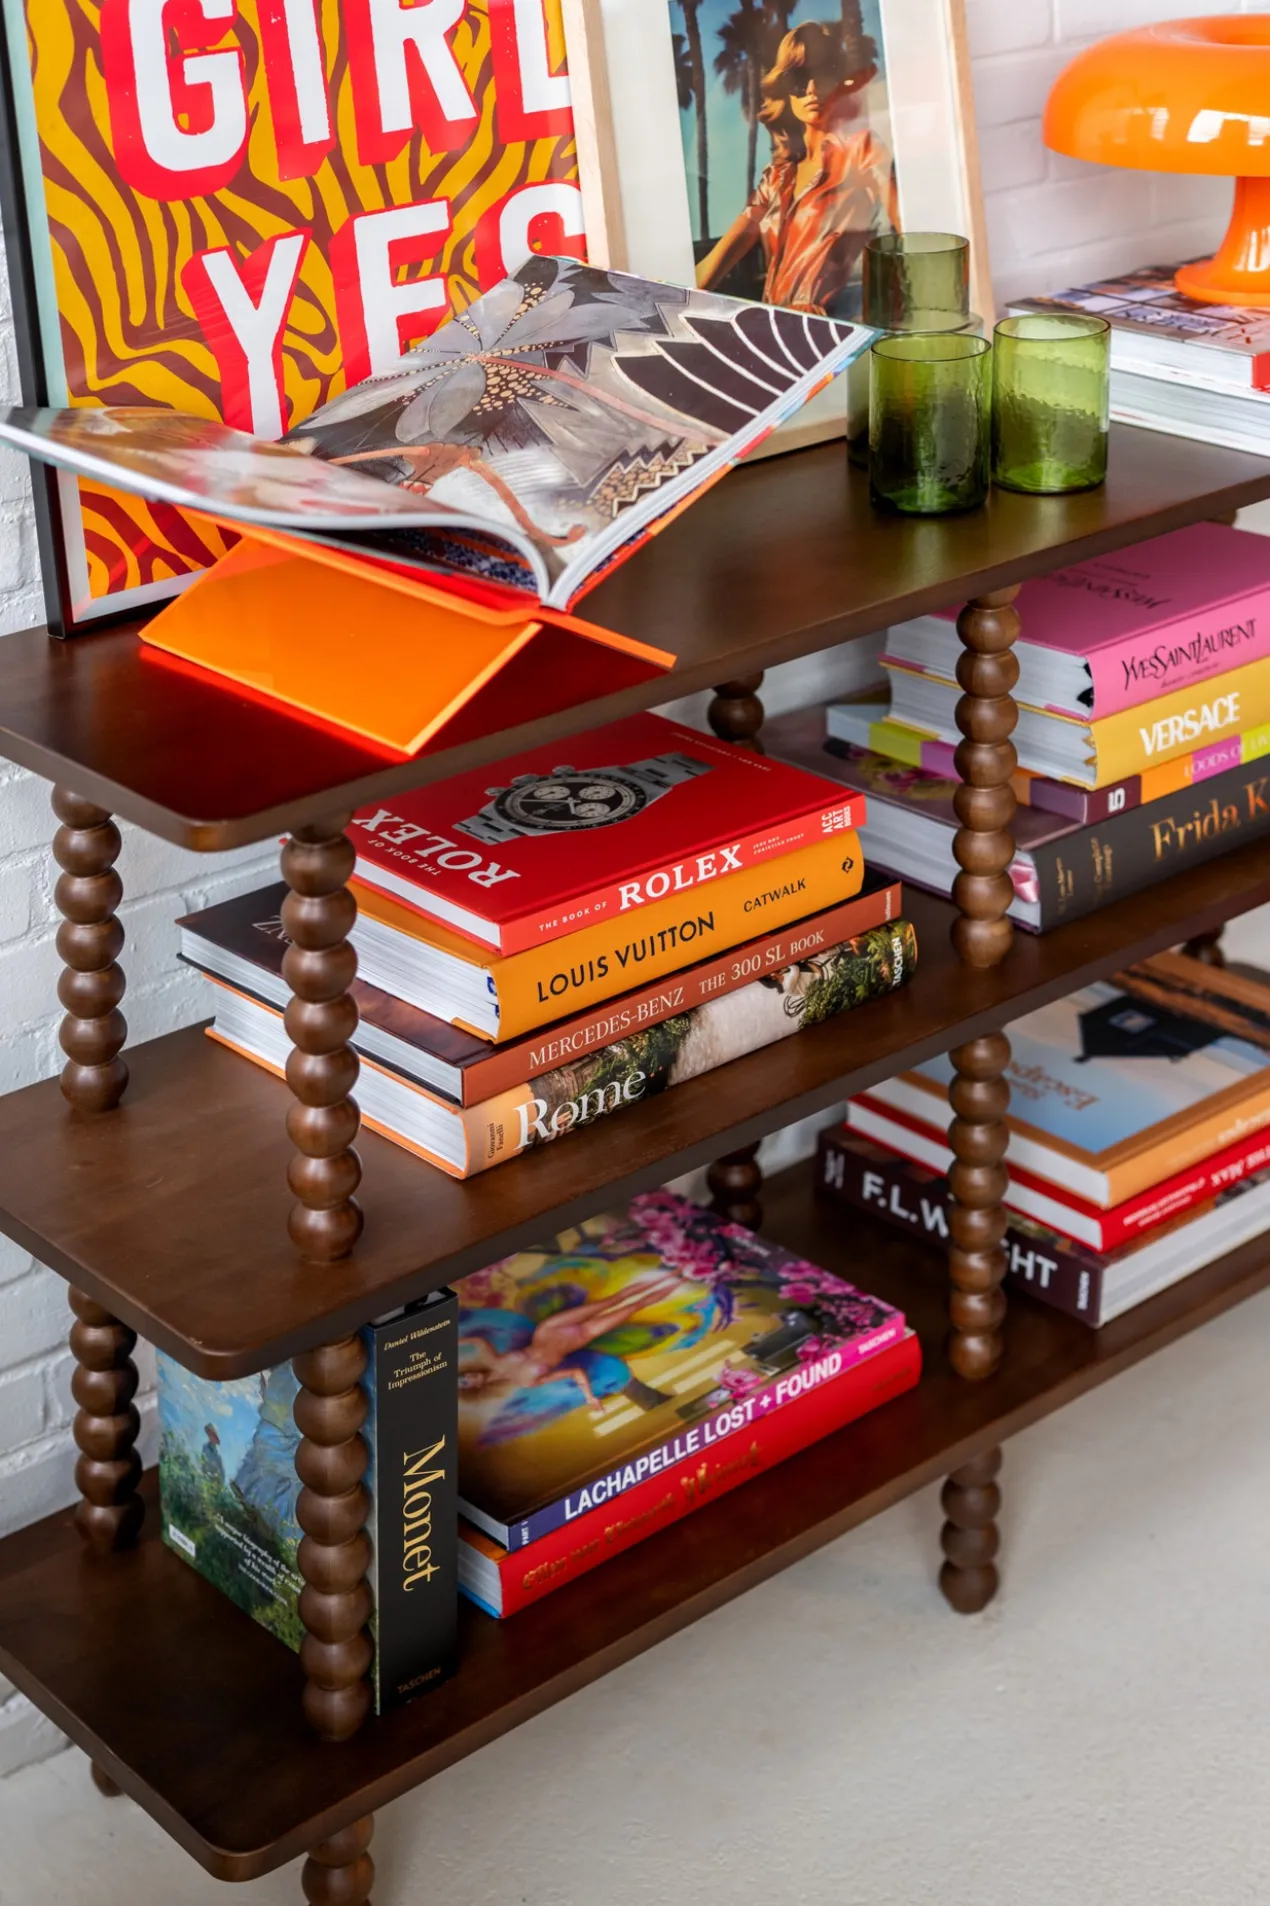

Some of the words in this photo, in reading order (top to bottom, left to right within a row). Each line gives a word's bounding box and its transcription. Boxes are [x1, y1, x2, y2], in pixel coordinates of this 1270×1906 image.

[112, 0, 573, 190] GIRL
[1139, 691, 1240, 757] VERSACE
[822, 812, 834, 833] ACC
[832, 808, 844, 829] ART
[1149, 798, 1241, 862] Frida
[351, 808, 522, 889] ROLEX
[367, 838, 385, 849] OF
[384, 846, 419, 865] BOOK
[417, 862, 443, 877] THE
[538, 918, 558, 932] THE
[561, 906, 591, 924] BOOK
[594, 900, 608, 912] OF
[618, 843, 744, 911] ROLEX
[536, 955, 609, 1004] LOUIS
[614, 911, 716, 970] VUITTON
[743, 877, 807, 913] CATWALK
[526, 986, 685, 1071] MERCEDES-BENZ
[698, 972, 726, 995] THE
[730, 950, 762, 981] 300
[765, 943, 786, 966] SL
[790, 929, 825, 955] BOOK
[514, 1069, 648, 1152] Rome
[487, 1122, 495, 1159] Giovanni
[384, 1334, 409, 1351] Daniel
[410, 1319, 452, 1341] Wildenstein
[393, 1357, 432, 1379] Triumph
[433, 1351, 443, 1363] of
[410, 1351, 427, 1362] The
[387, 1360, 449, 1391] Impressionism
[564, 1428, 700, 1521] LACHAPELLE
[704, 1398, 756, 1444] LOST
[775, 1351, 843, 1405] FOUND
[402, 1433, 446, 1593] Monet
[396, 1666, 442, 1695] TASCHEN
